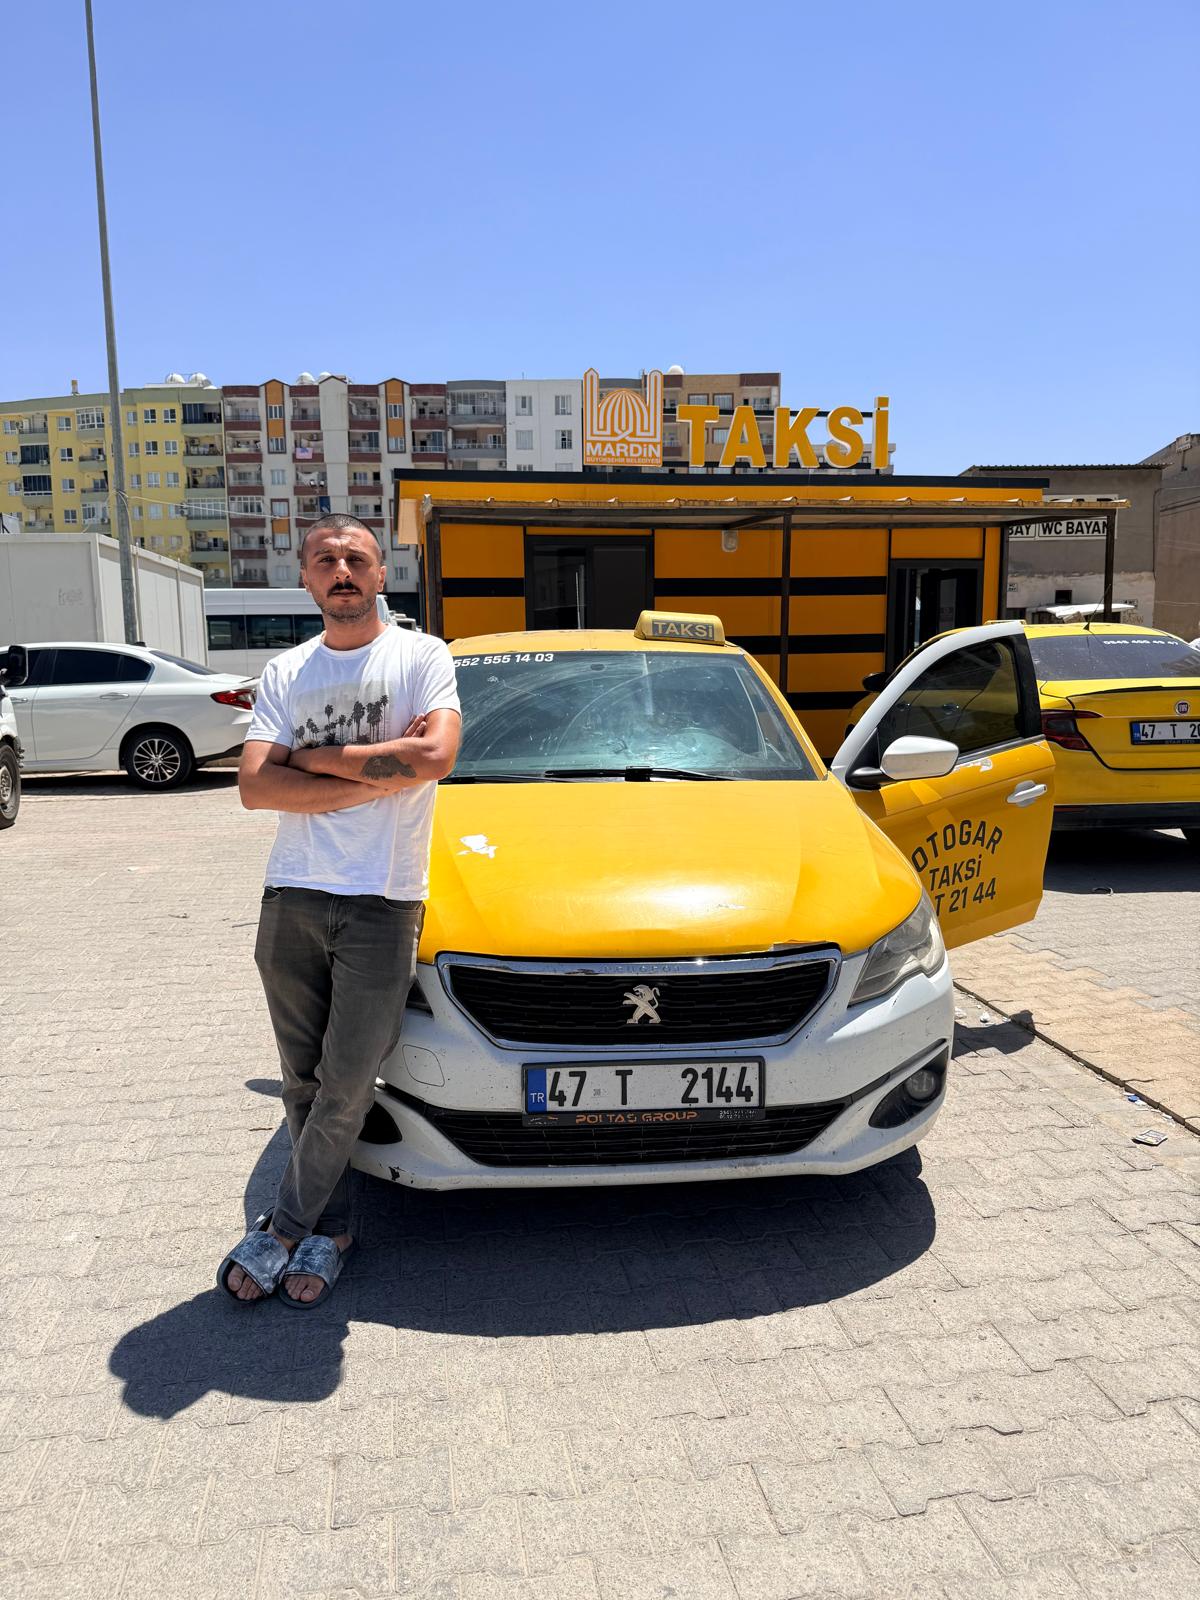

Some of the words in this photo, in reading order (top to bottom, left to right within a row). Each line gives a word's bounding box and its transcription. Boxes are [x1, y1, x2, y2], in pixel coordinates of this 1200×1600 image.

[1042, 522, 1062, 535] WC
[454, 657, 480, 668] 552
[483, 655, 511, 665] 555
[515, 654, 531, 663] 14
[535, 653, 554, 662] 03
[1141, 724, 1156, 739] 47
[1170, 724, 1178, 738] T
[911, 819, 1003, 873] OTOGAR
[934, 893, 945, 917] T
[530, 1092, 545, 1103] TR
[548, 1071, 587, 1107] 47
[615, 1069, 633, 1105] T
[680, 1067, 753, 1104] 2144
[641, 1111, 699, 1123] GROUP
